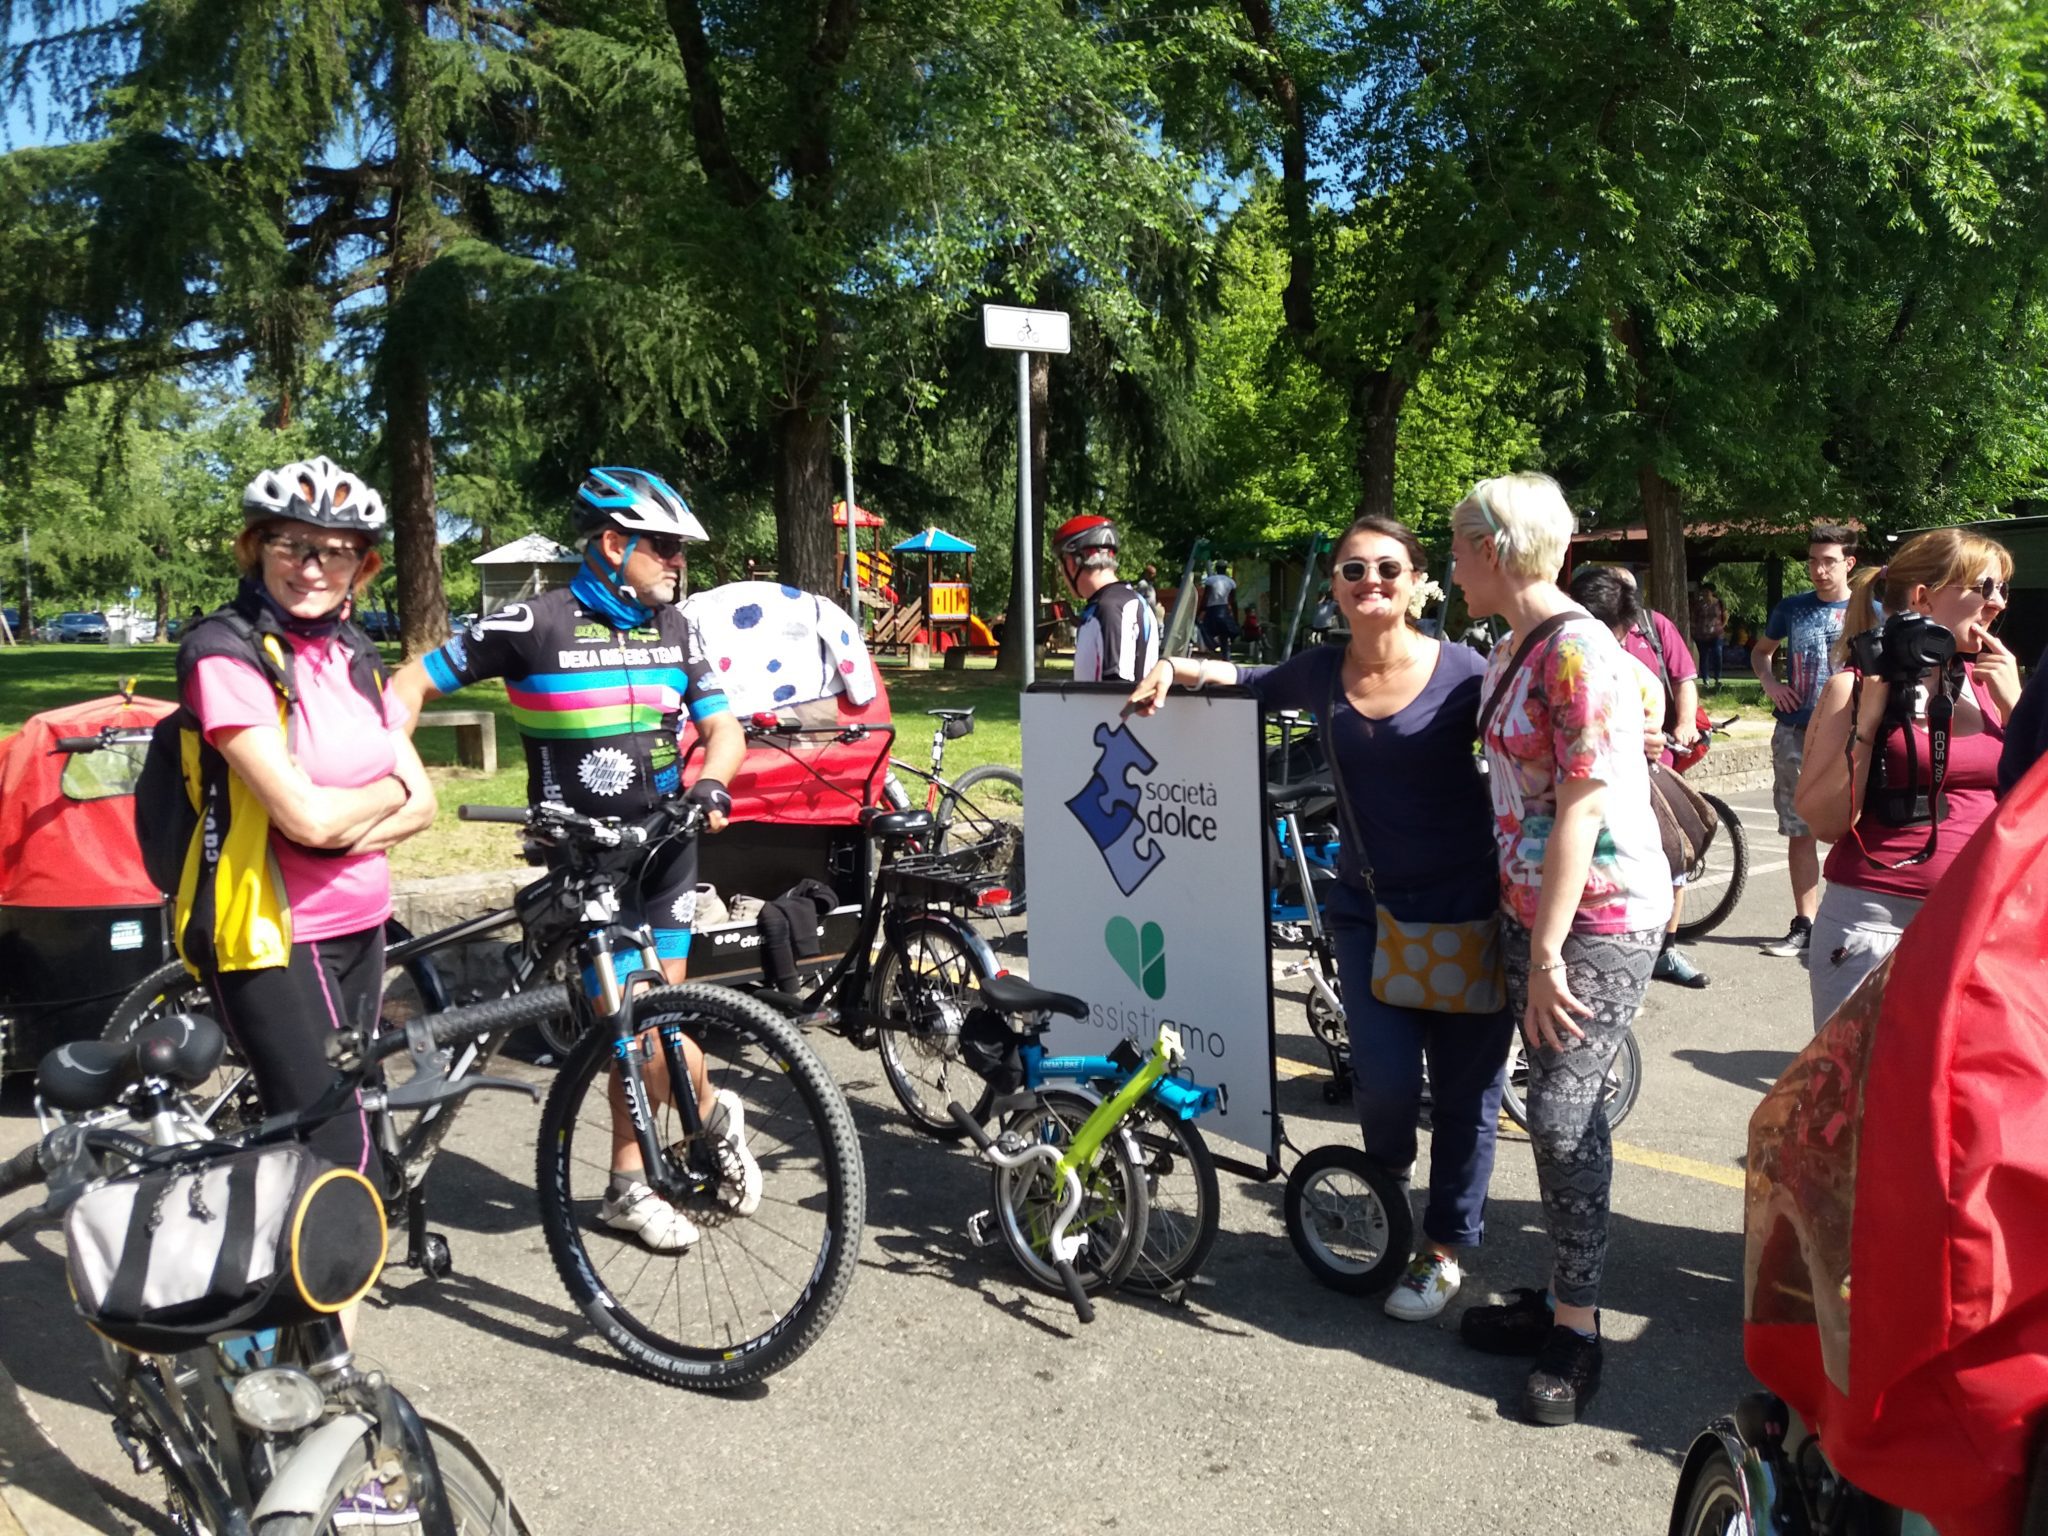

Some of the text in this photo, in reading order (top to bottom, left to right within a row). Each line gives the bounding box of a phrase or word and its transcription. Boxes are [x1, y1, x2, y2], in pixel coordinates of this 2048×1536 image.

[558, 649, 600, 668] DEKA
[1934, 730, 1946, 783] EOS 70D
[1145, 779, 1217, 806] società
[1147, 803, 1217, 841] dolce
[1042, 1060, 1080, 1069] DEMO BIKE
[642, 1349, 672, 1370] BLACK
[671, 1361, 711, 1376] PANTHER
